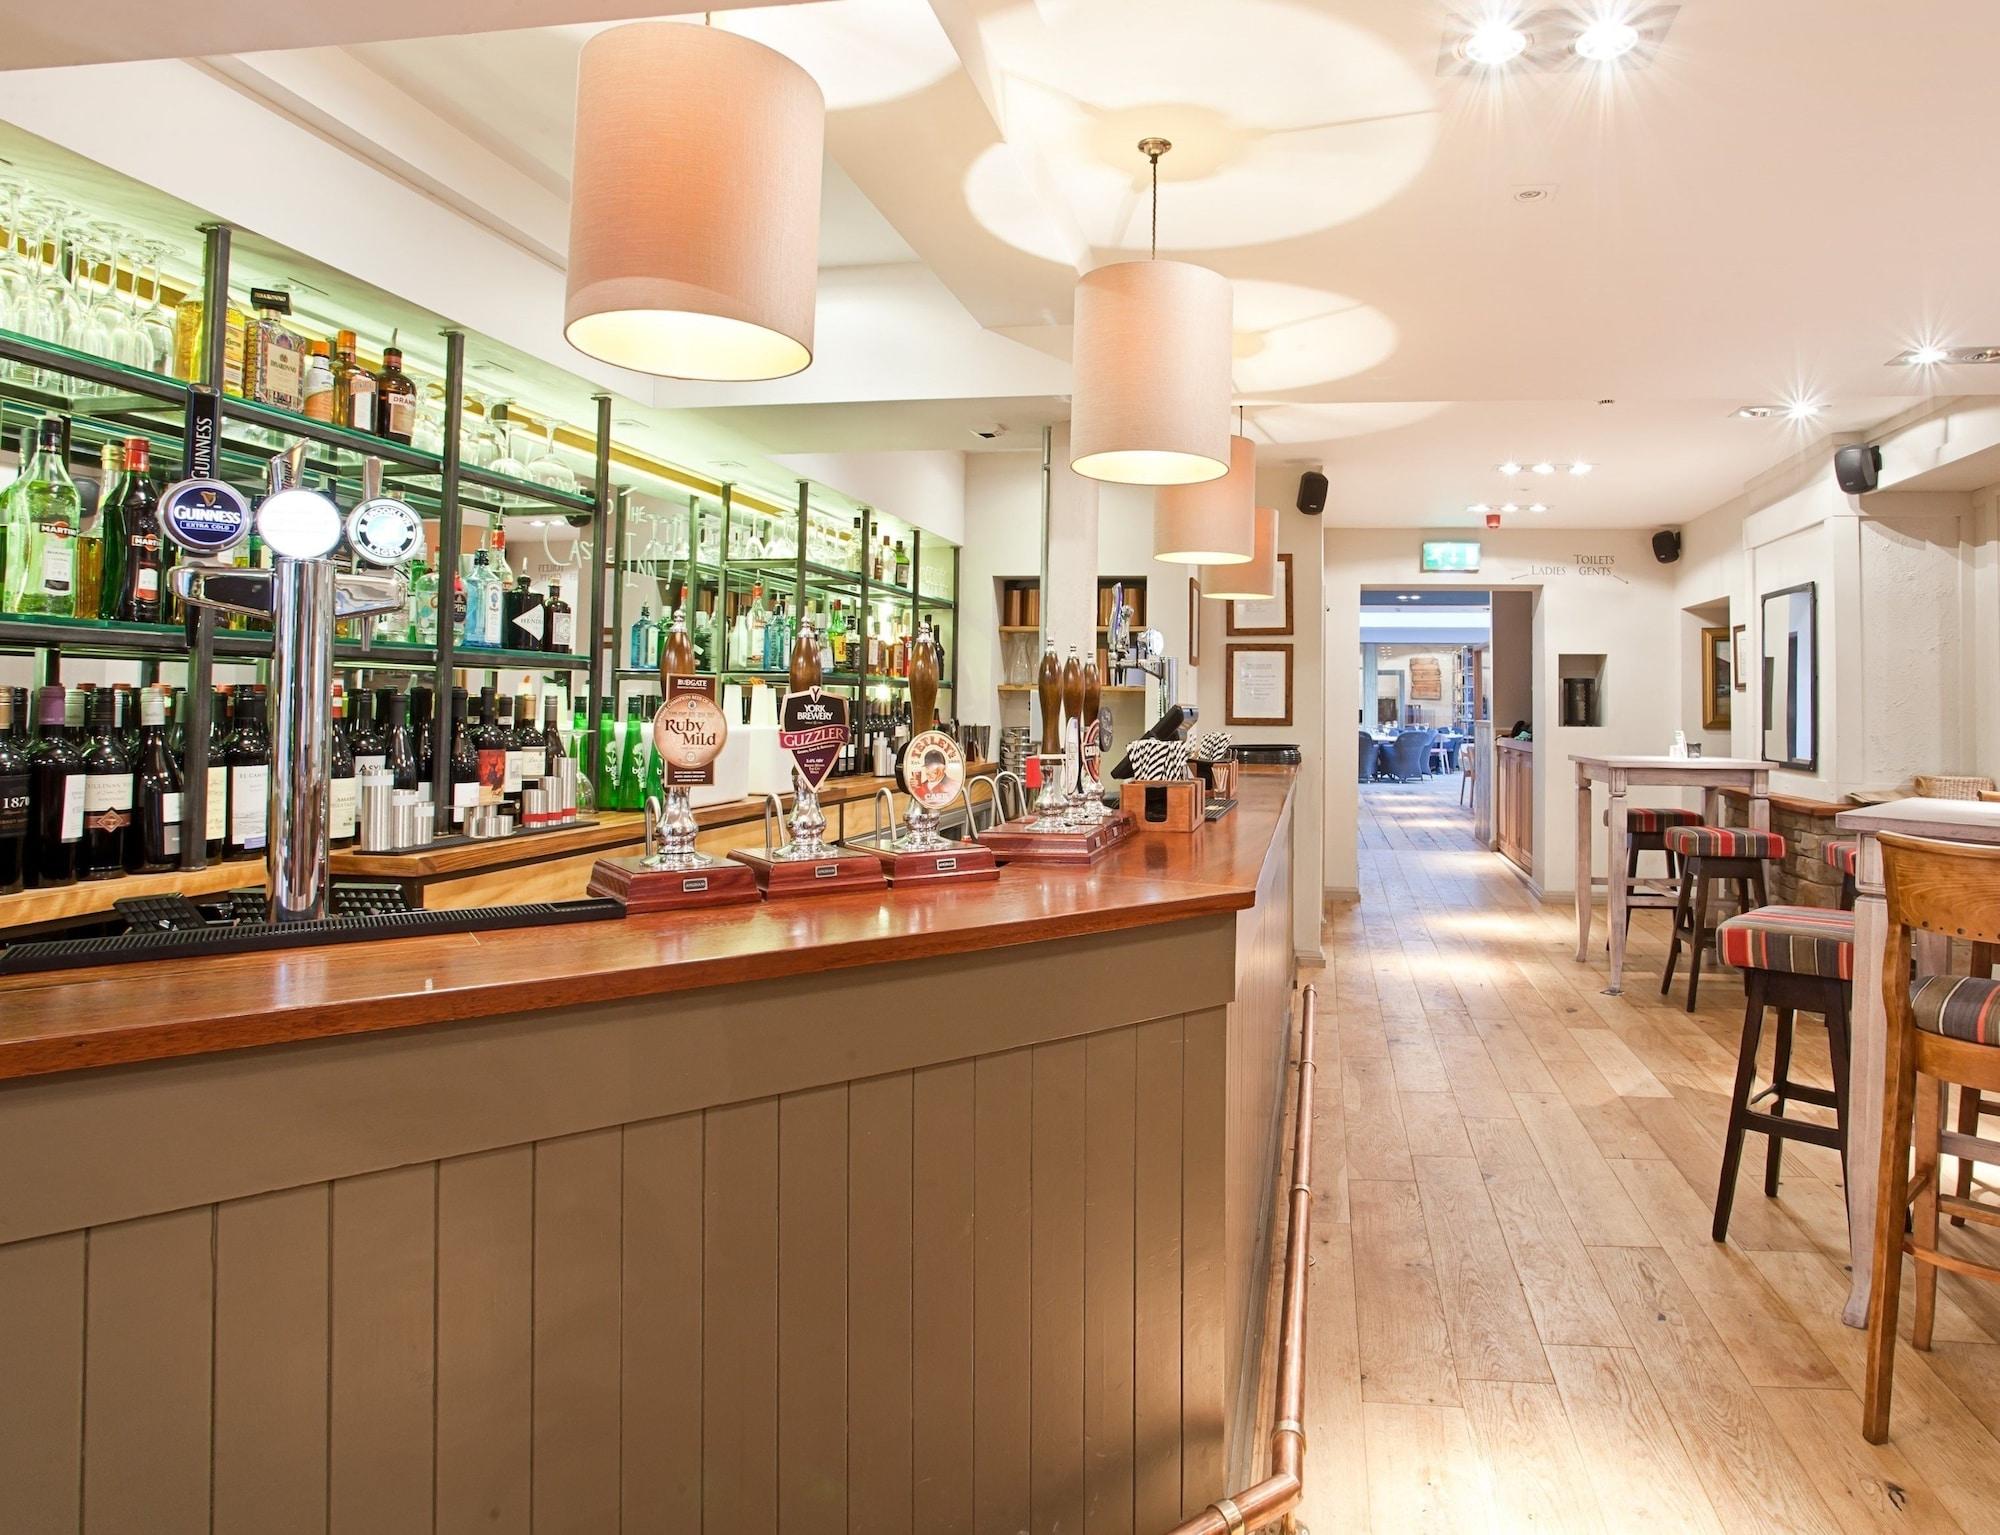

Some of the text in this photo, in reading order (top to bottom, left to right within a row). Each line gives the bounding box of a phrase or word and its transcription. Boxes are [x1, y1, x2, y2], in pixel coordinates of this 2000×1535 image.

[191, 415, 213, 480] GUINNESS
[173, 504, 241, 525] GUINNESS
[185, 521, 231, 532] EXTRA COLD
[1572, 553, 1615, 566] TOILETS
[1531, 564, 1612, 577] LADIES GENTS
[804, 704, 826, 713] YORK
[797, 711, 834, 721] BREWERY
[665, 718, 705, 735] Ruby
[783, 727, 845, 747] GUZZLER
[3, 796, 30, 809] 1870
